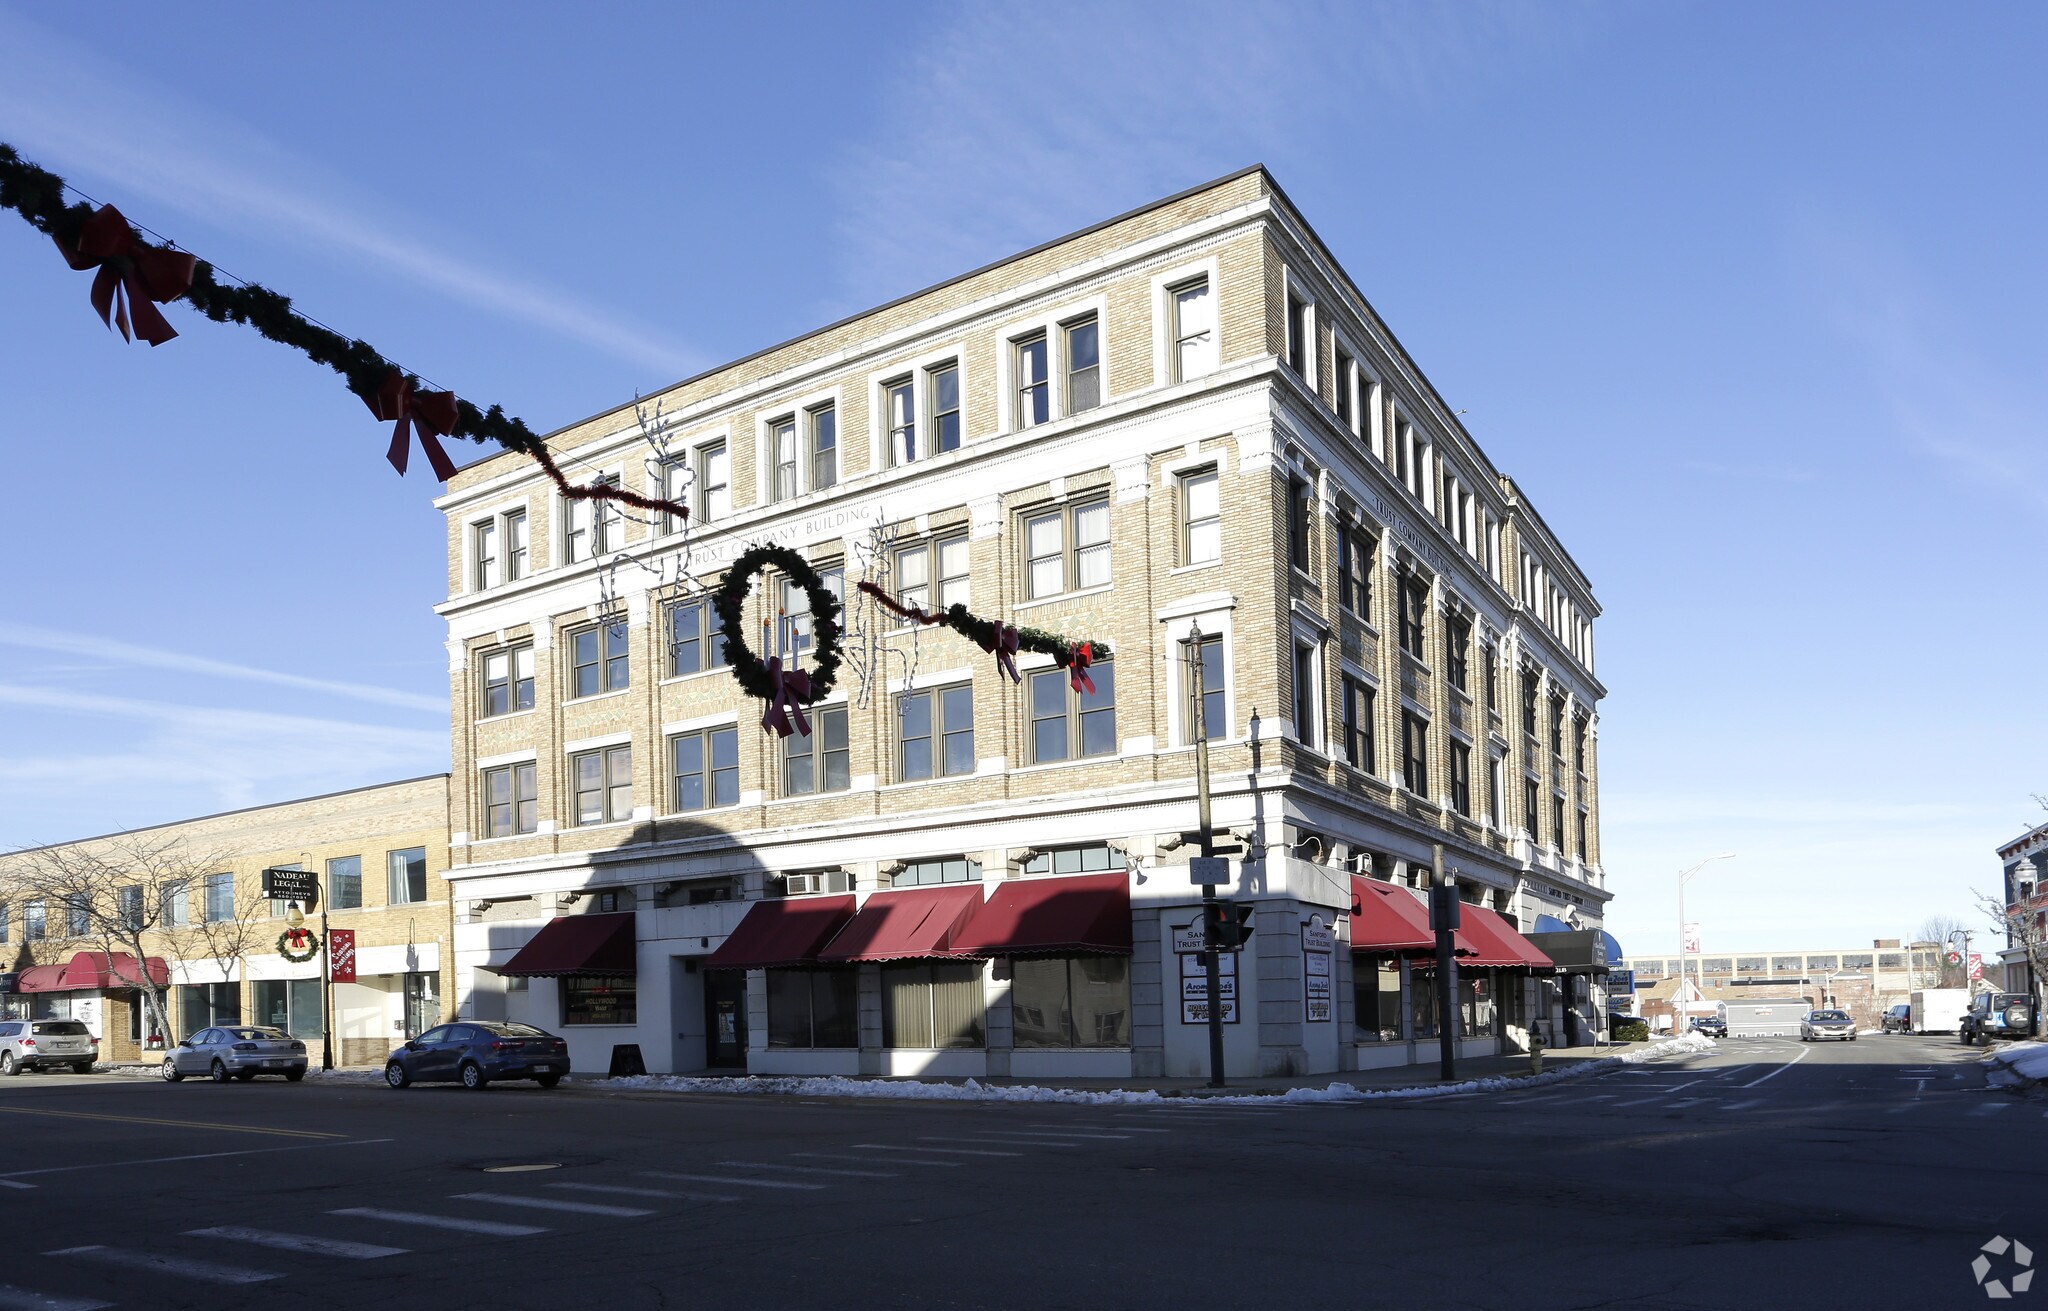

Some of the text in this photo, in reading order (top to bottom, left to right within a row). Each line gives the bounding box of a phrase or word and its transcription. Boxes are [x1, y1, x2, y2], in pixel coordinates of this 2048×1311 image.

[688, 506, 870, 567] TRUST COMPANY BUILDING
[1374, 497, 1453, 580] TRUST COMPANY BUILDING
[273, 871, 310, 880] NADEAU
[273, 879, 302, 888] LEGAL
[1309, 930, 1328, 939] SANFORD
[1177, 940, 1201, 948] TRUST
[1305, 938, 1316, 946] TRUST
[332, 948, 355, 971] Greetings
[1185, 982, 1208, 990] Arom
